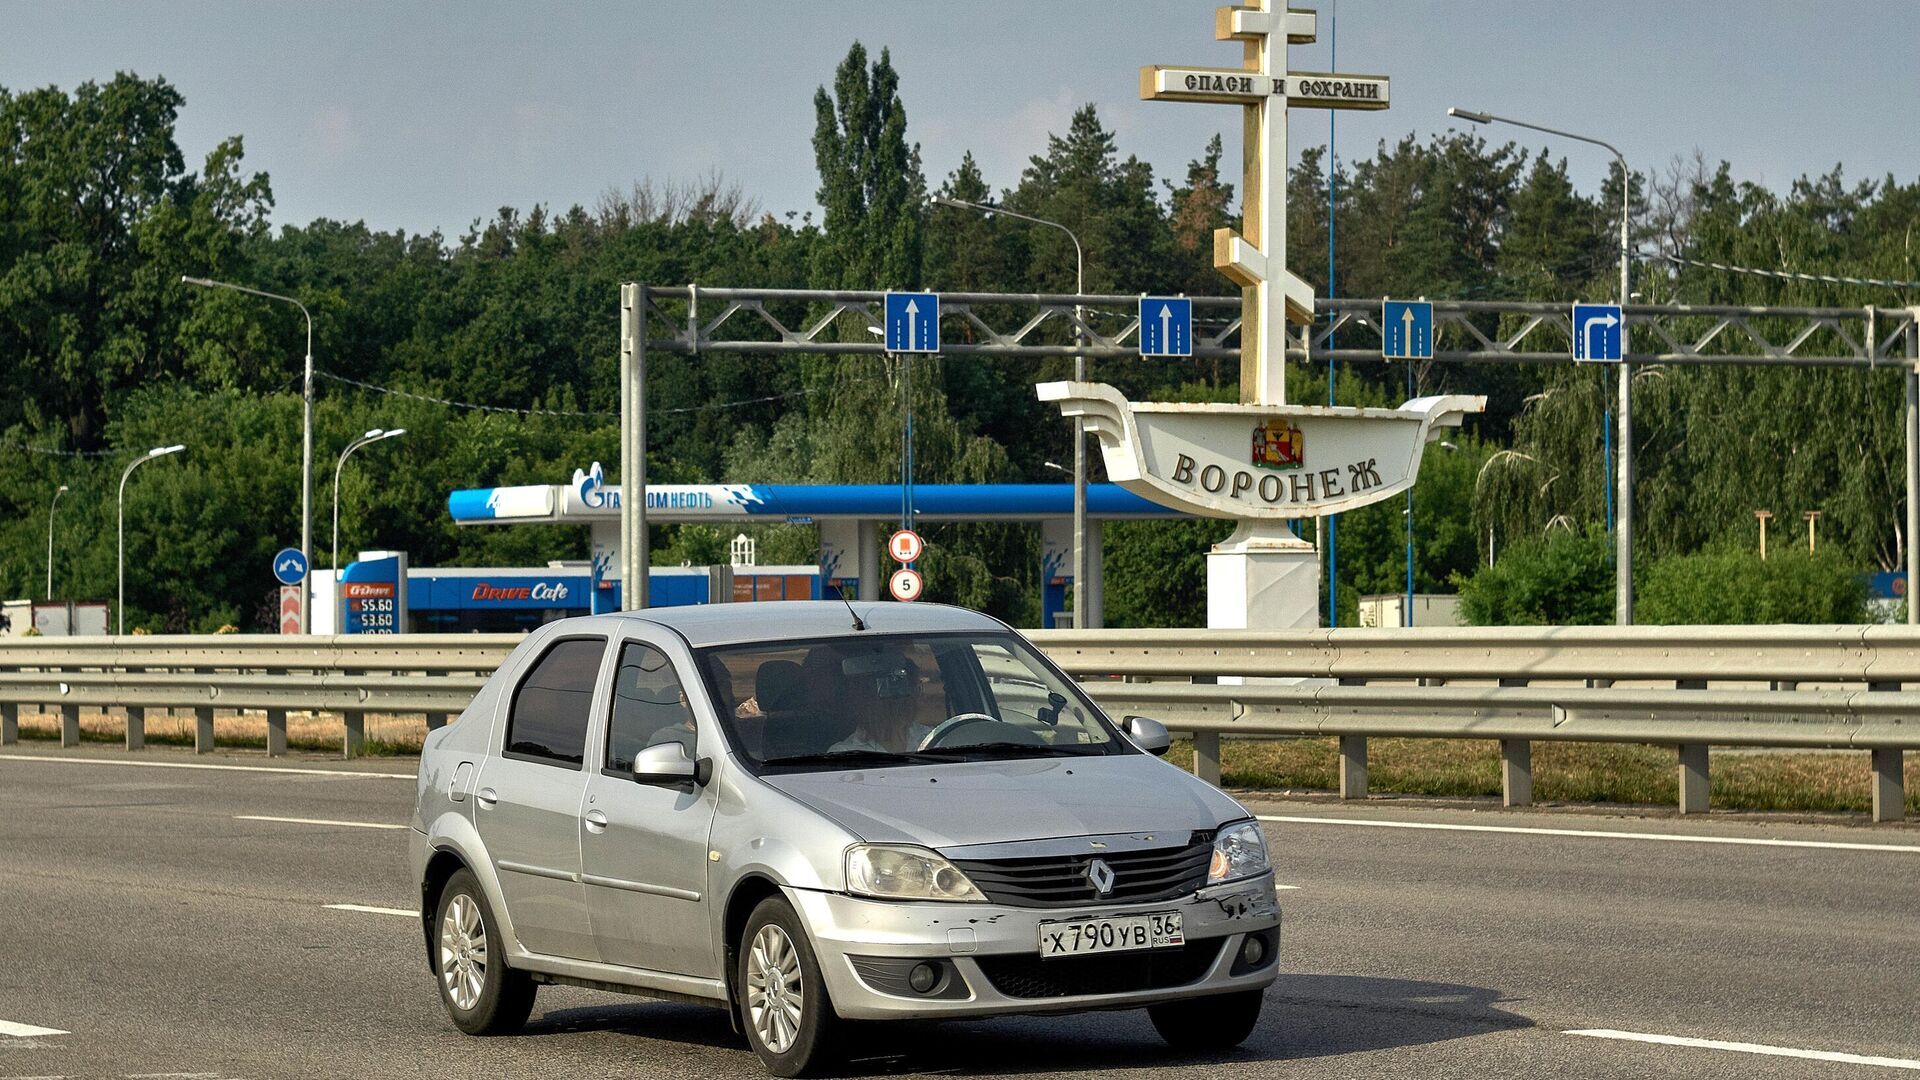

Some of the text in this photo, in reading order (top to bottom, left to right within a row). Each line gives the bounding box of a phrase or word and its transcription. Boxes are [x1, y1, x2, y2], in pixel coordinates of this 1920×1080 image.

[1185, 74, 1379, 99] СПАСИ И СОХРАНИ
[1172, 453, 1382, 503] ВОРОНЕЖ
[902, 579, 911, 592] 5
[361, 599, 392, 611] 55.60
[361, 614, 392, 626] 53.60
[1050, 916, 1175, 953] Х790УВ 36
[1153, 936, 1170, 944] RUS
